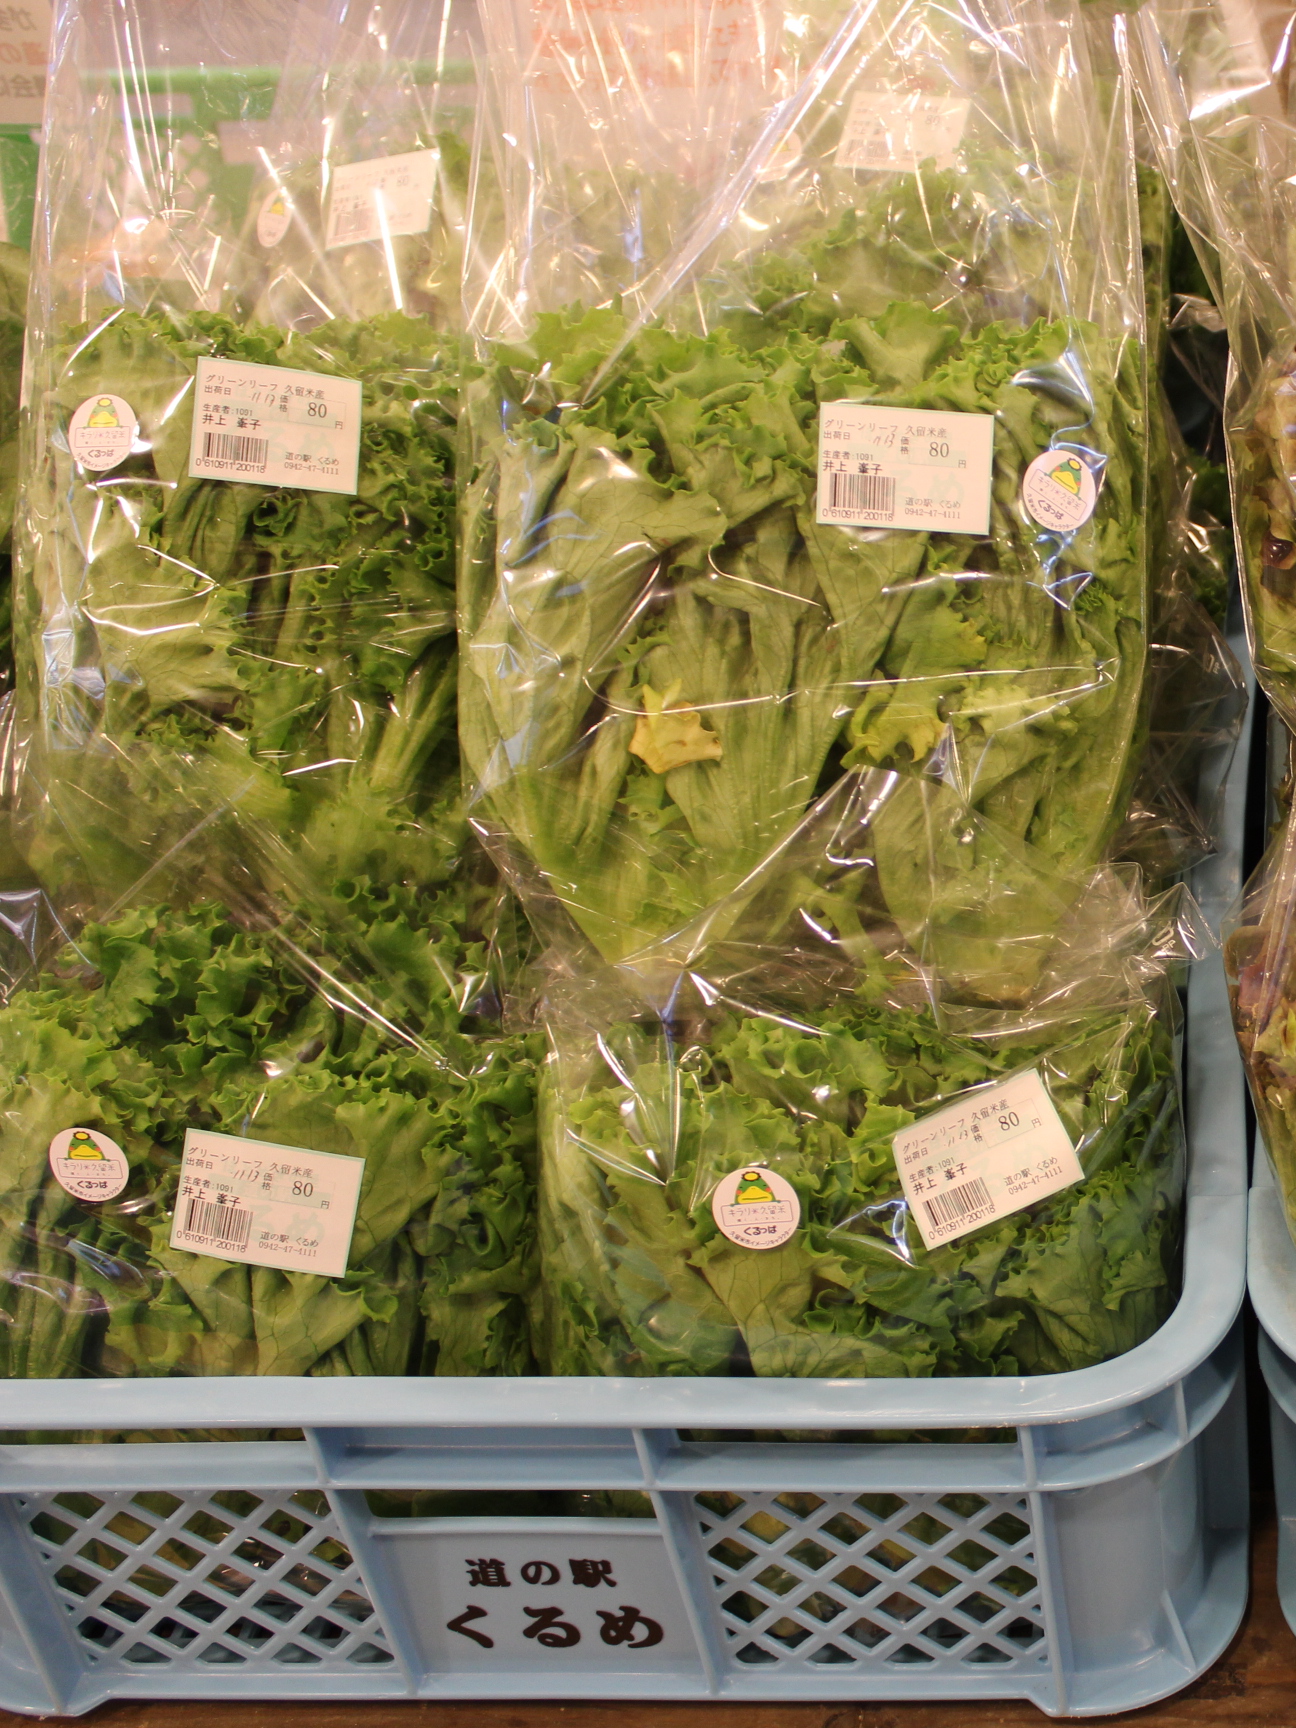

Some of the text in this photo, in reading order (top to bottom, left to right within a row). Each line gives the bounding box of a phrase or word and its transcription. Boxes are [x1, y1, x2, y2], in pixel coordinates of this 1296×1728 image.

[204, 385, 231, 395] 出荷日
[206, 374, 325, 399] グリーンリーフ 久留米産
[202, 413, 226, 426] 井上
[308, 402, 343, 430] 80 円
[823, 431, 850, 440] 出荷日
[825, 419, 947, 438] グリーンリーフ 久留米産
[285, 452, 339, 466] 道の駅 くるめ
[929, 442, 966, 468] 80 円
[196, 458, 265, 473] 0 610911 200118
[284, 462, 339, 475] 0942-47-4111
[823, 460, 847, 472] 井上
[905, 497, 960, 508] 道の駅 くるめ
[822, 508, 893, 521] 0 610911 200118
[905, 508, 960, 519] 0942-47-4111
[903, 1099, 1009, 1154] グリーンリーフ 久留米産
[999, 1112, 1042, 1132] 80 円
[186, 1157, 213, 1169] 出荷日
[188, 1147, 313, 1179] グリーンリーフ 久留米産
[904, 1148, 928, 1165] 出荷日
[1003, 1157, 1057, 1186] 道の駅 くるめ
[913, 1178, 937, 1195] 井上
[1008, 1166, 1063, 1195] 0942-47-4111
[182, 1186, 206, 1200] 井上
[292, 1181, 330, 1209] 80 円
[929, 1205, 995, 1240] 0 610911 200118
[185, 1232, 213, 1245] 610911
[216, 1240, 246, 1253] 200118
[260, 1232, 318, 1247] 道の駅 くるめ
[465, 1558, 617, 1588] 道の駅
[447, 1605, 663, 1648] くるめ
